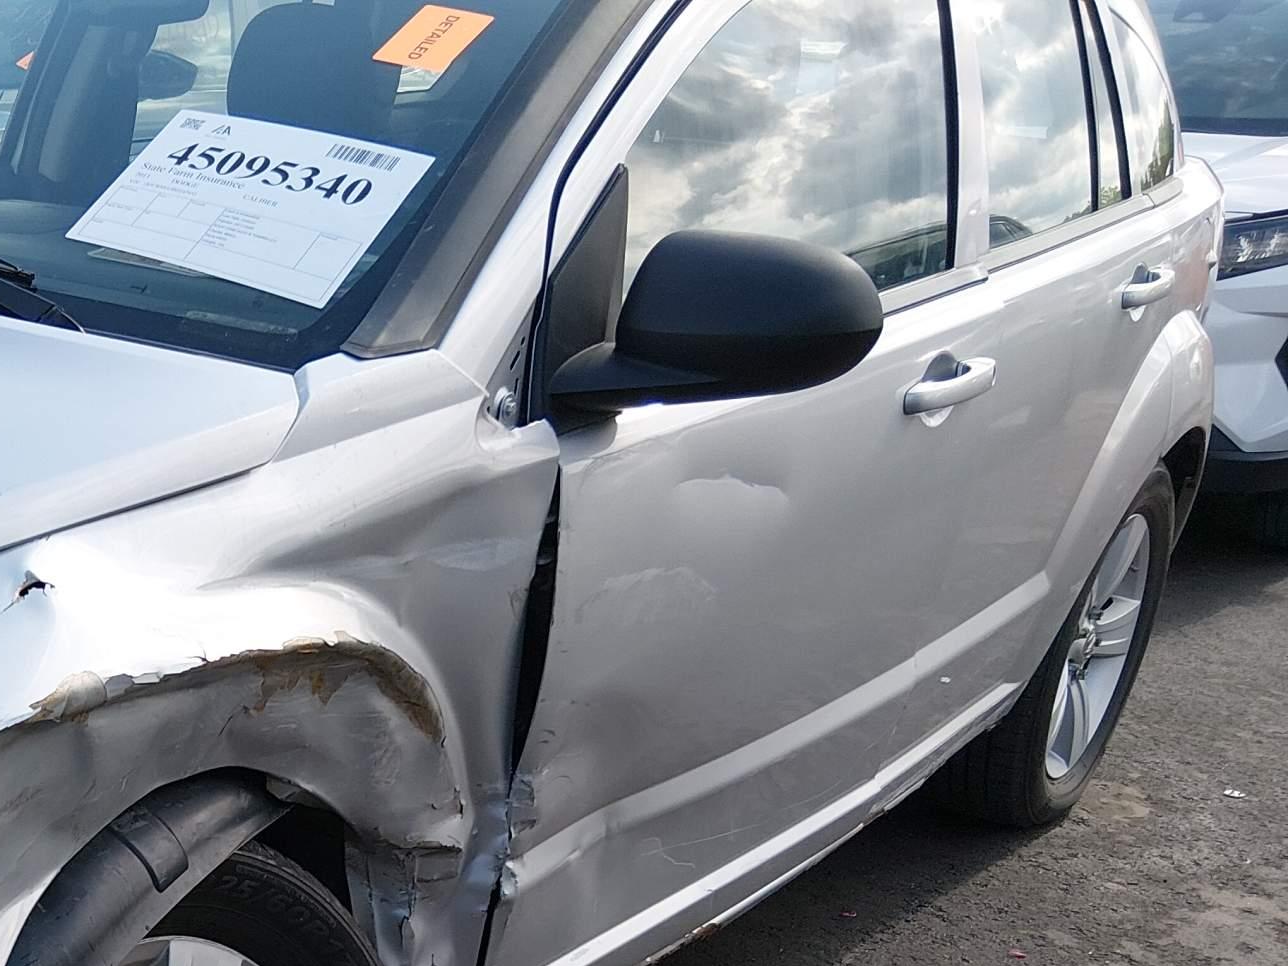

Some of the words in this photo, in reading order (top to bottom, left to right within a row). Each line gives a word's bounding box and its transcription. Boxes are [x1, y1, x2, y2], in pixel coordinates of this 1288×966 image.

[407, 15, 461, 60] DETAILED
[142, 161, 166, 173] State
[168, 166, 193, 180] Farm
[195, 170, 246, 189] Insurance
[167, 142, 373, 205] 45095340
